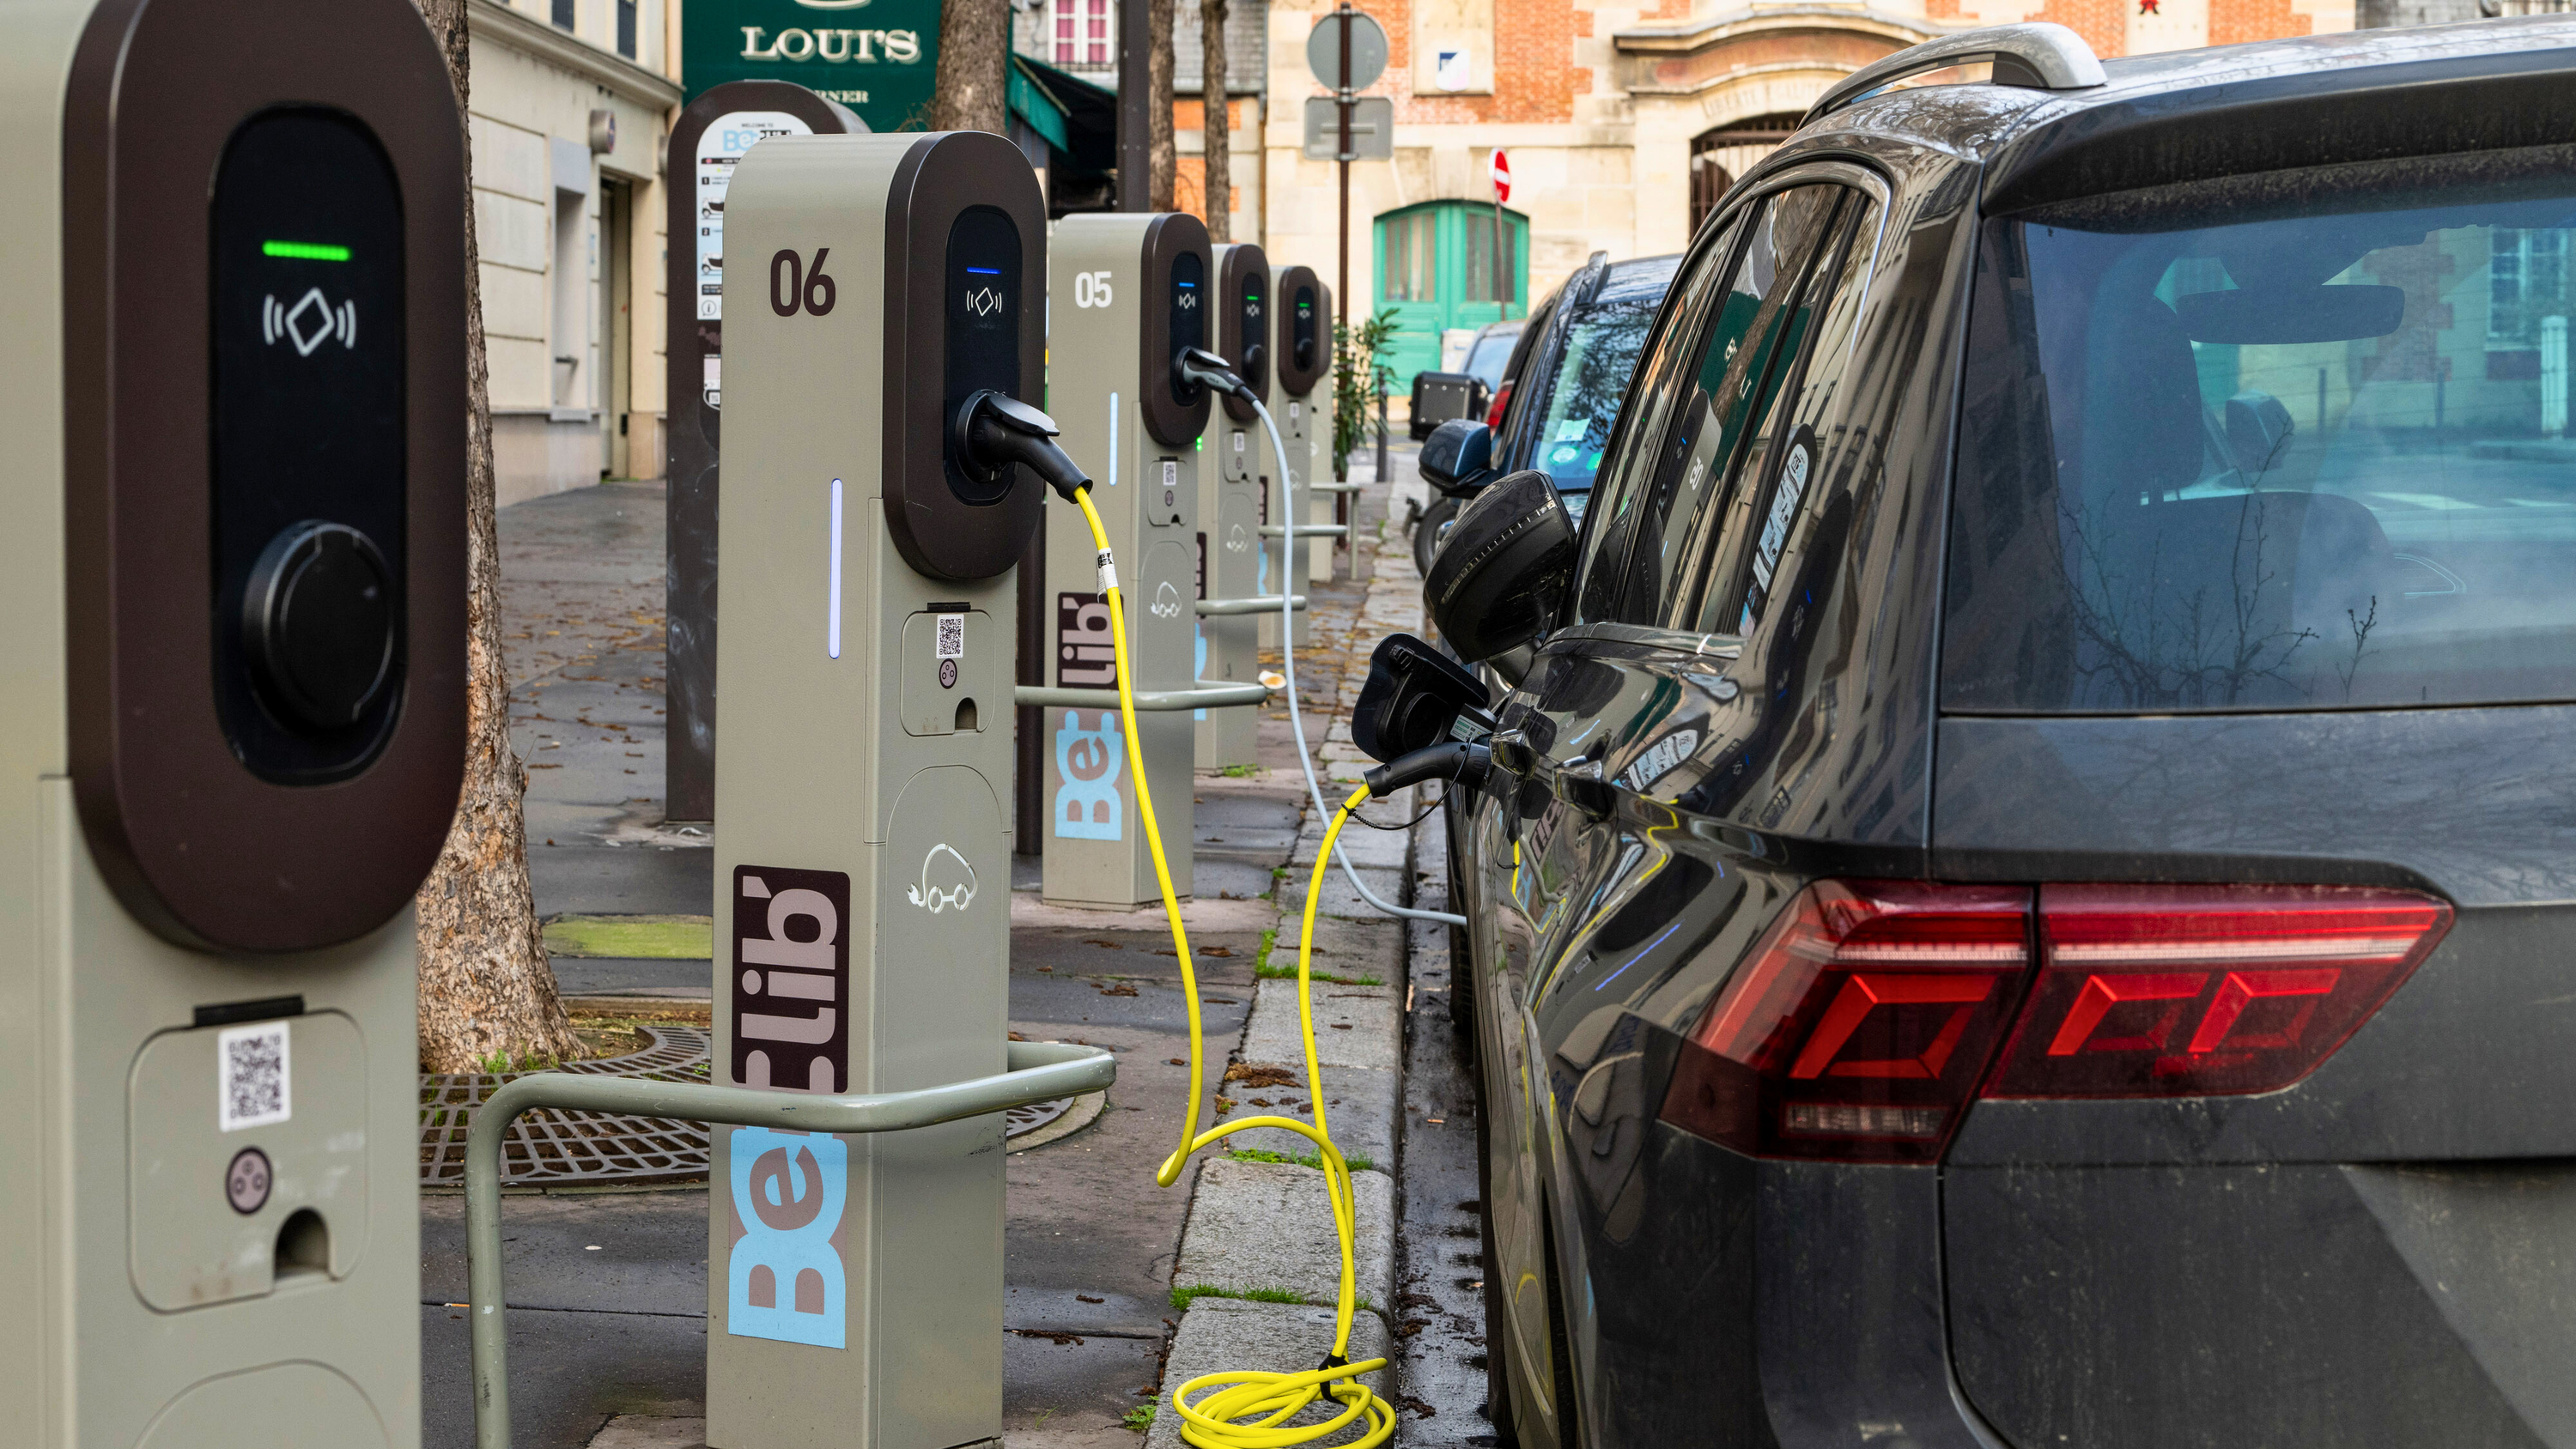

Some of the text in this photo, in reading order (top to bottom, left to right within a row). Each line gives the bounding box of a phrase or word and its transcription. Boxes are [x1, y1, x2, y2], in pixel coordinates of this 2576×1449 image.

[740, 26, 921, 64] LOUI'S
[770, 247, 836, 317] 06
[1075, 270, 1113, 308] 05
